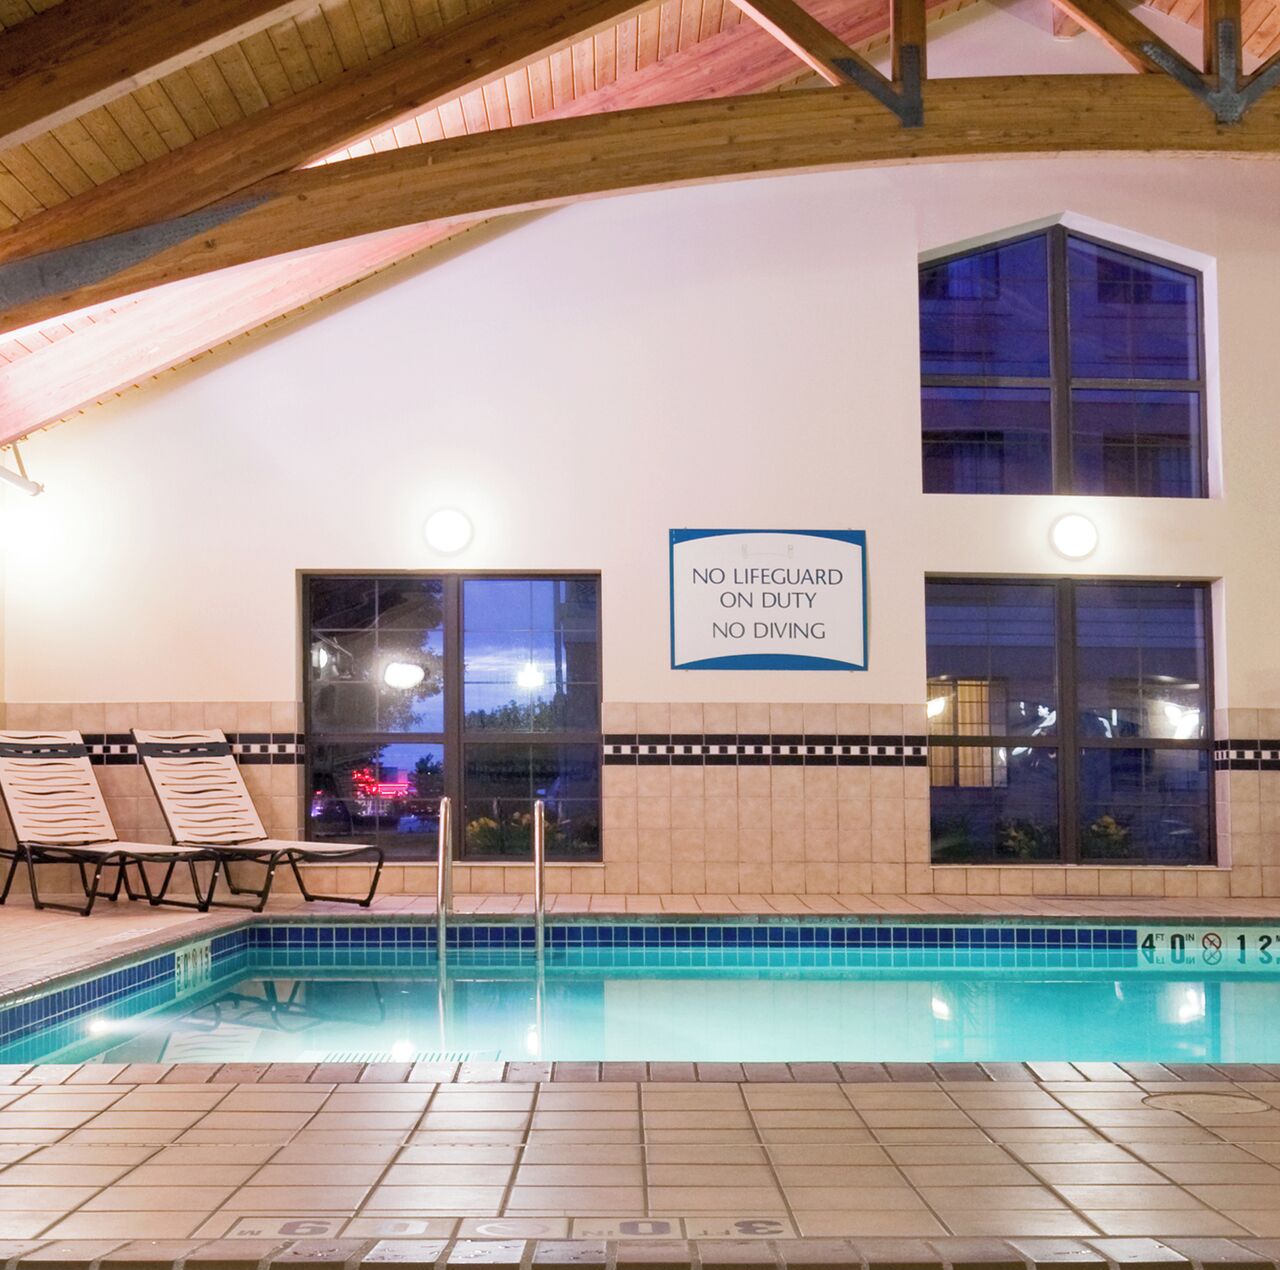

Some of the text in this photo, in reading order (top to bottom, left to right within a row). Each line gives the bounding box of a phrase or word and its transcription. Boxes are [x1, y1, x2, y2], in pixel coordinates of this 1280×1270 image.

[692, 568, 844, 585] NO LIFEGUARD
[719, 591, 817, 608] ON DUTY
[712, 622, 826, 639] NO DIVING
[1141, 933, 1156, 949] 4
[1155, 933, 1165, 941] FT
[1185, 933, 1195, 941] IN
